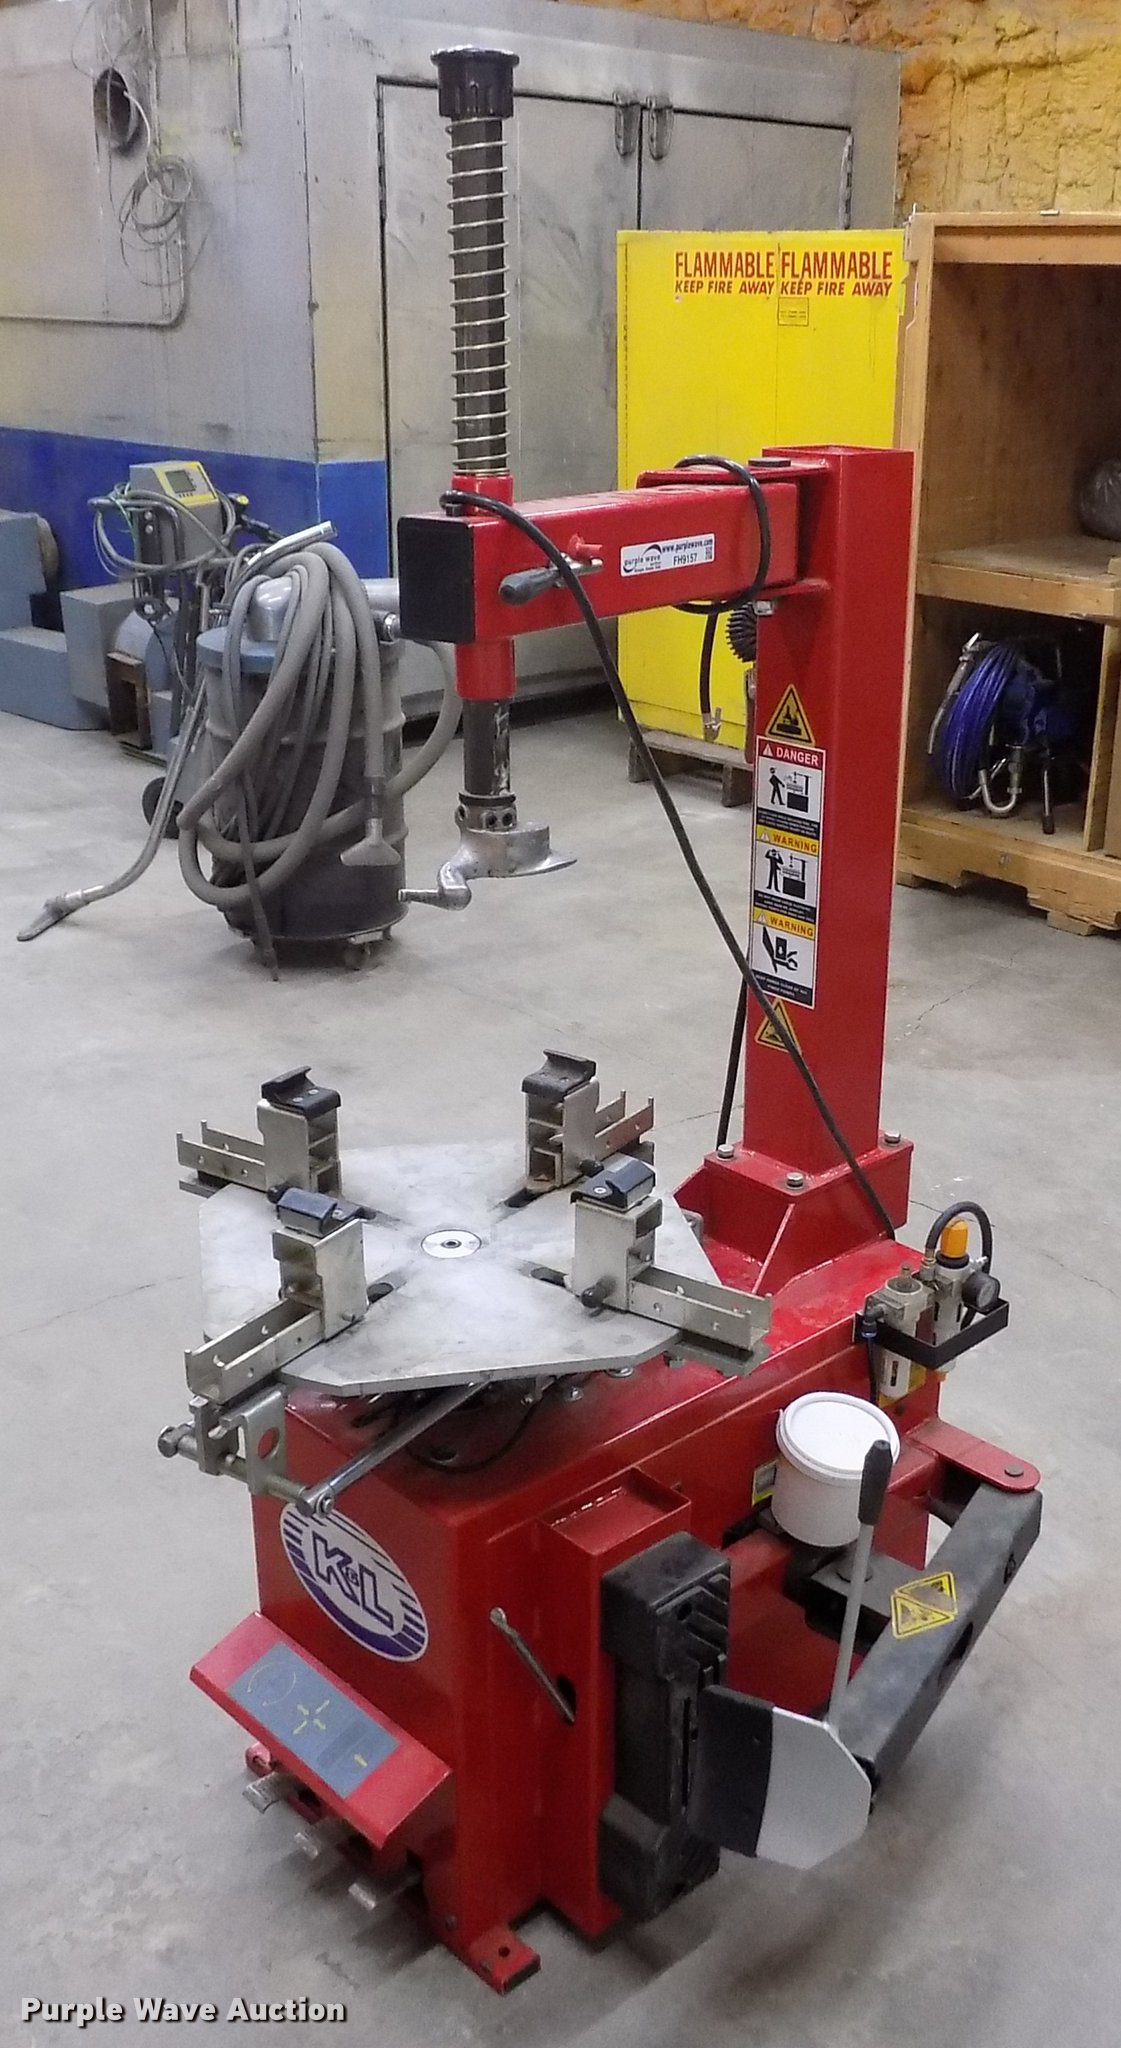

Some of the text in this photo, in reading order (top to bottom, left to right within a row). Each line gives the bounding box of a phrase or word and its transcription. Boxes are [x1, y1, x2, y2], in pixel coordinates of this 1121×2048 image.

[675, 252, 775, 279] FLAMMABLE
[781, 251, 893, 280] FLAMMABLE
[675, 280, 775, 295] KEEP FIRE AWAY
[780, 281, 893, 297] KEEP FIRE AWAY
[661, 539, 712, 553] www.purplewave.com
[624, 556, 643, 568] purple
[673, 552, 698, 566] FH9157
[776, 747, 819, 766] DANGER
[773, 833, 817, 853] WARNING
[770, 916, 814, 937] WARNING
